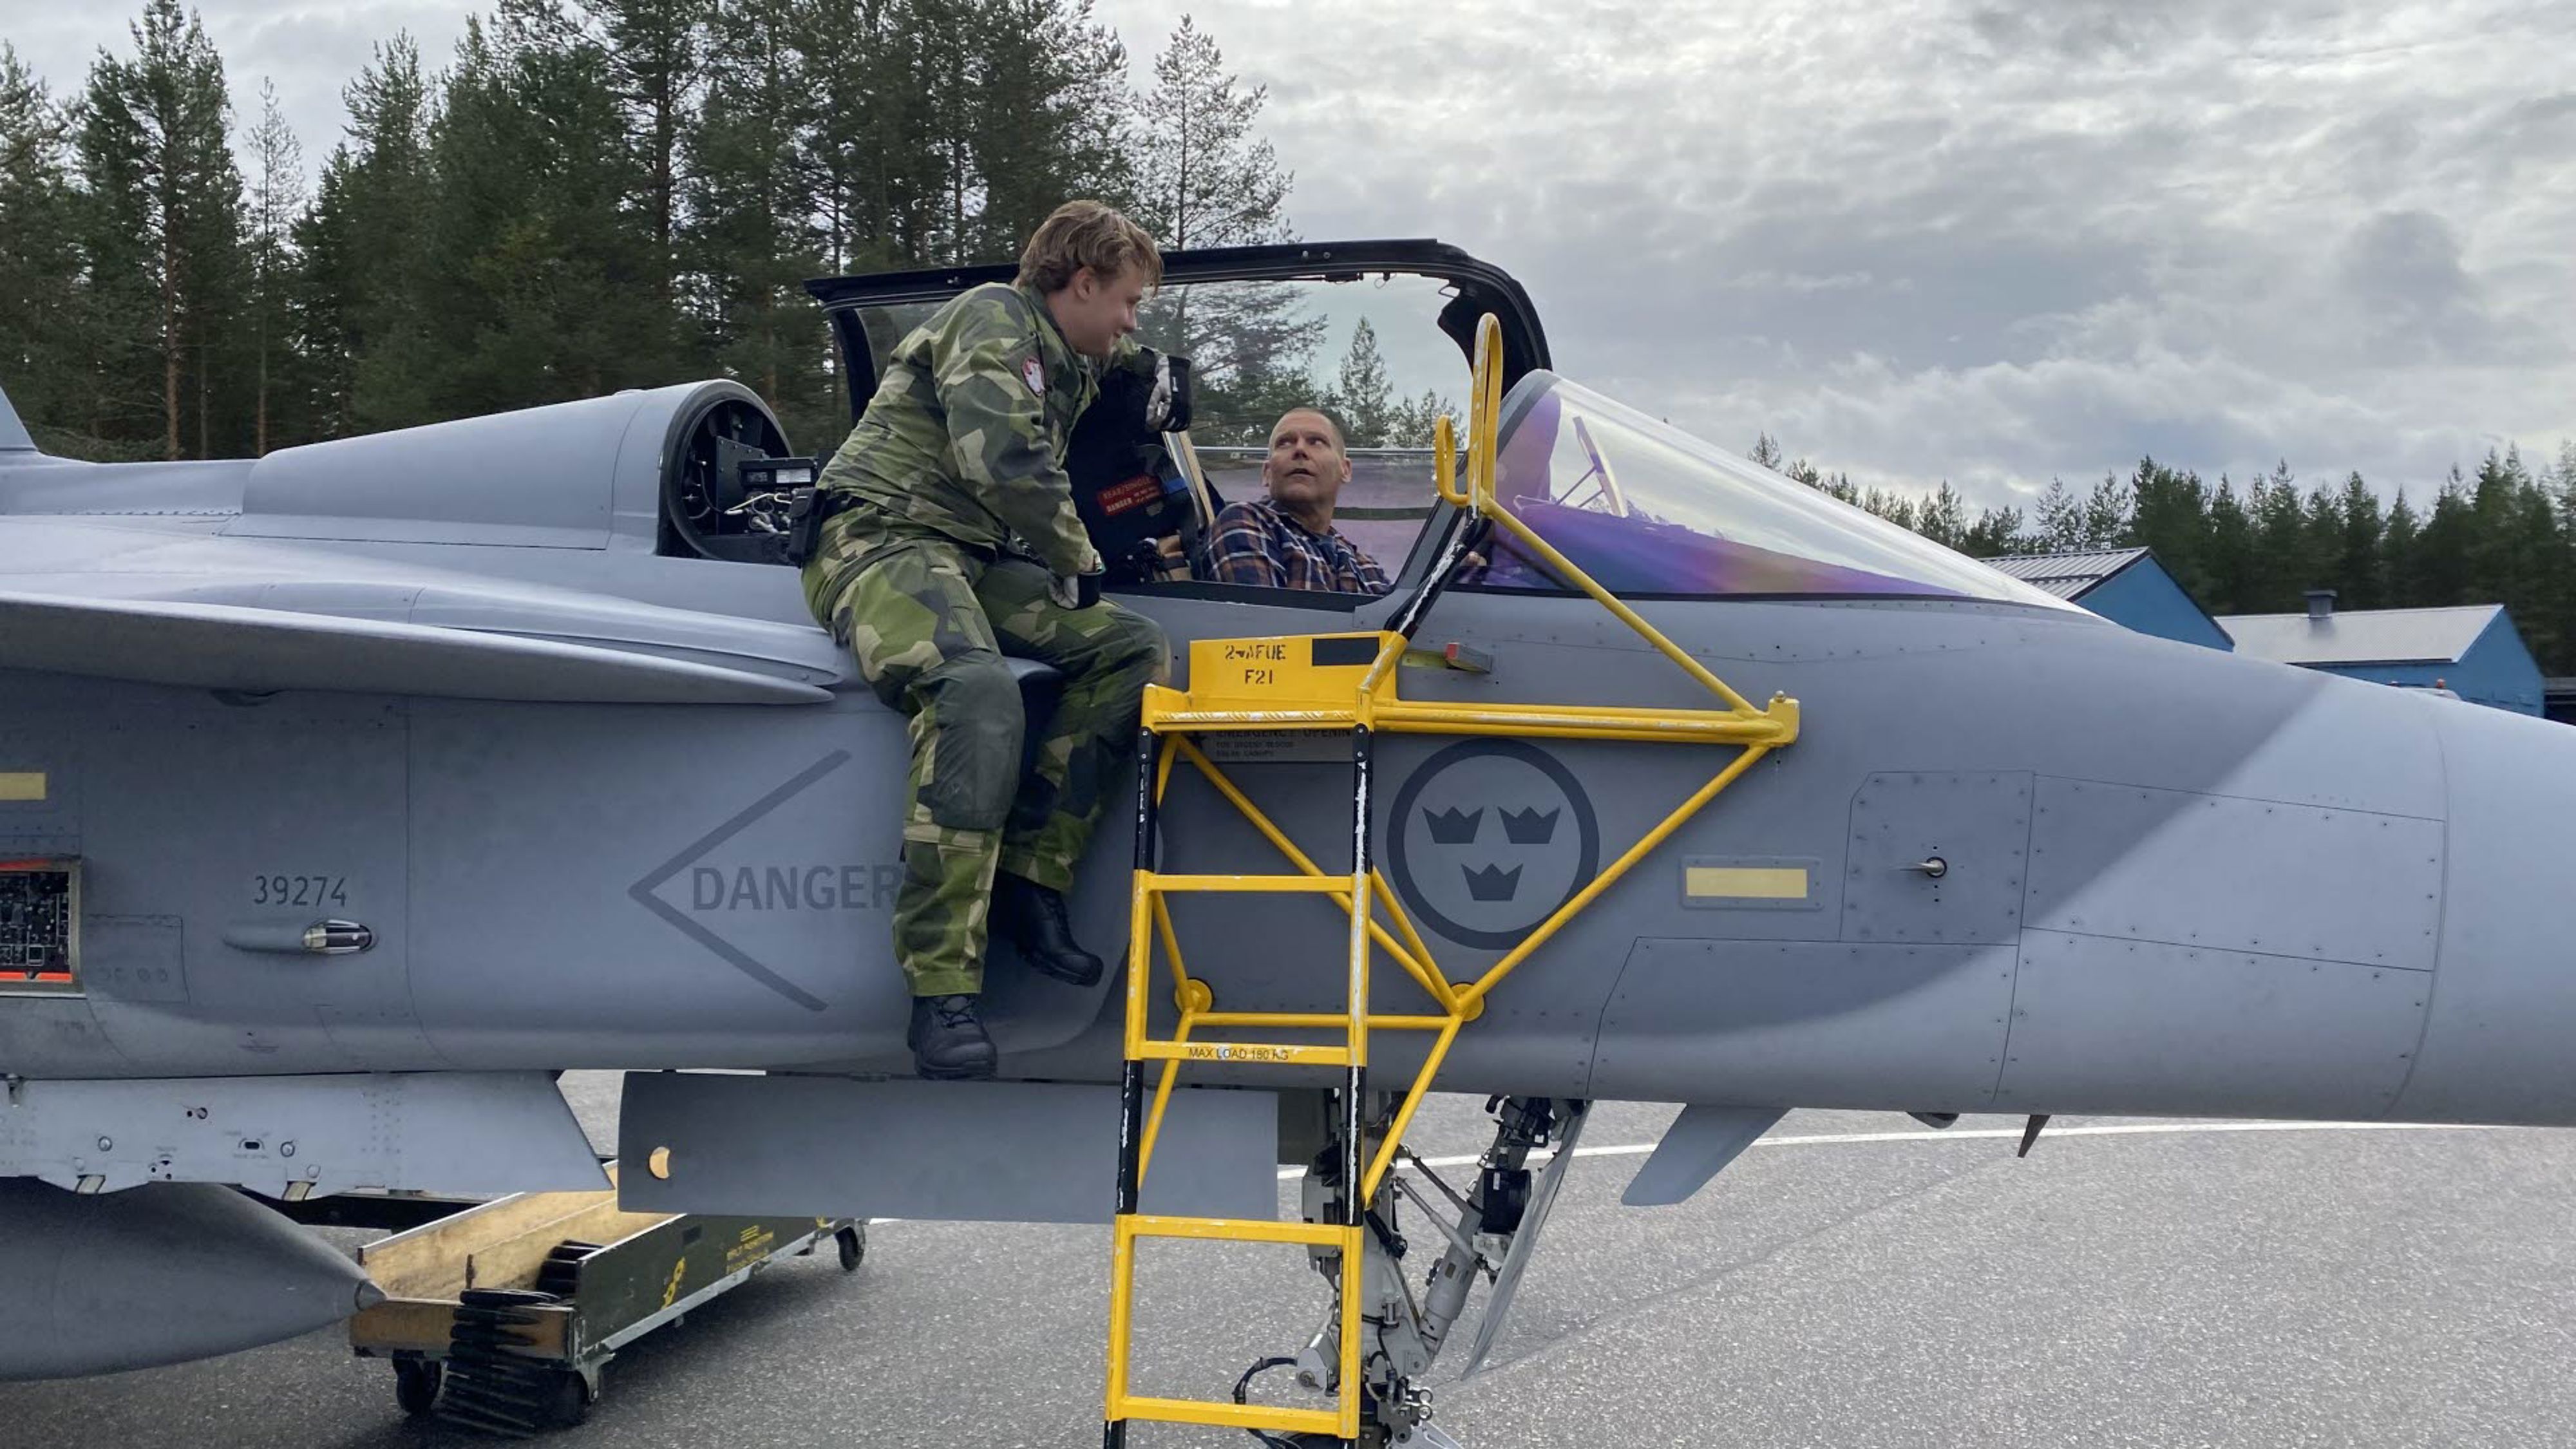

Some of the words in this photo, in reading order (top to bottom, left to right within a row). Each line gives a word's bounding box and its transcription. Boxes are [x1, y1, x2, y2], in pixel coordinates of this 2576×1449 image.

[1106, 497, 1133, 513] DANGER
[1244, 668, 1274, 685] F21
[1303, 728, 1352, 737] OPENIN
[254, 875, 346, 907] 39274
[692, 865, 904, 911] DANGER
[1188, 1047, 1213, 1058] MAX
[1216, 1048, 1247, 1059] LOAD
[1251, 1049, 1270, 1060] 180
